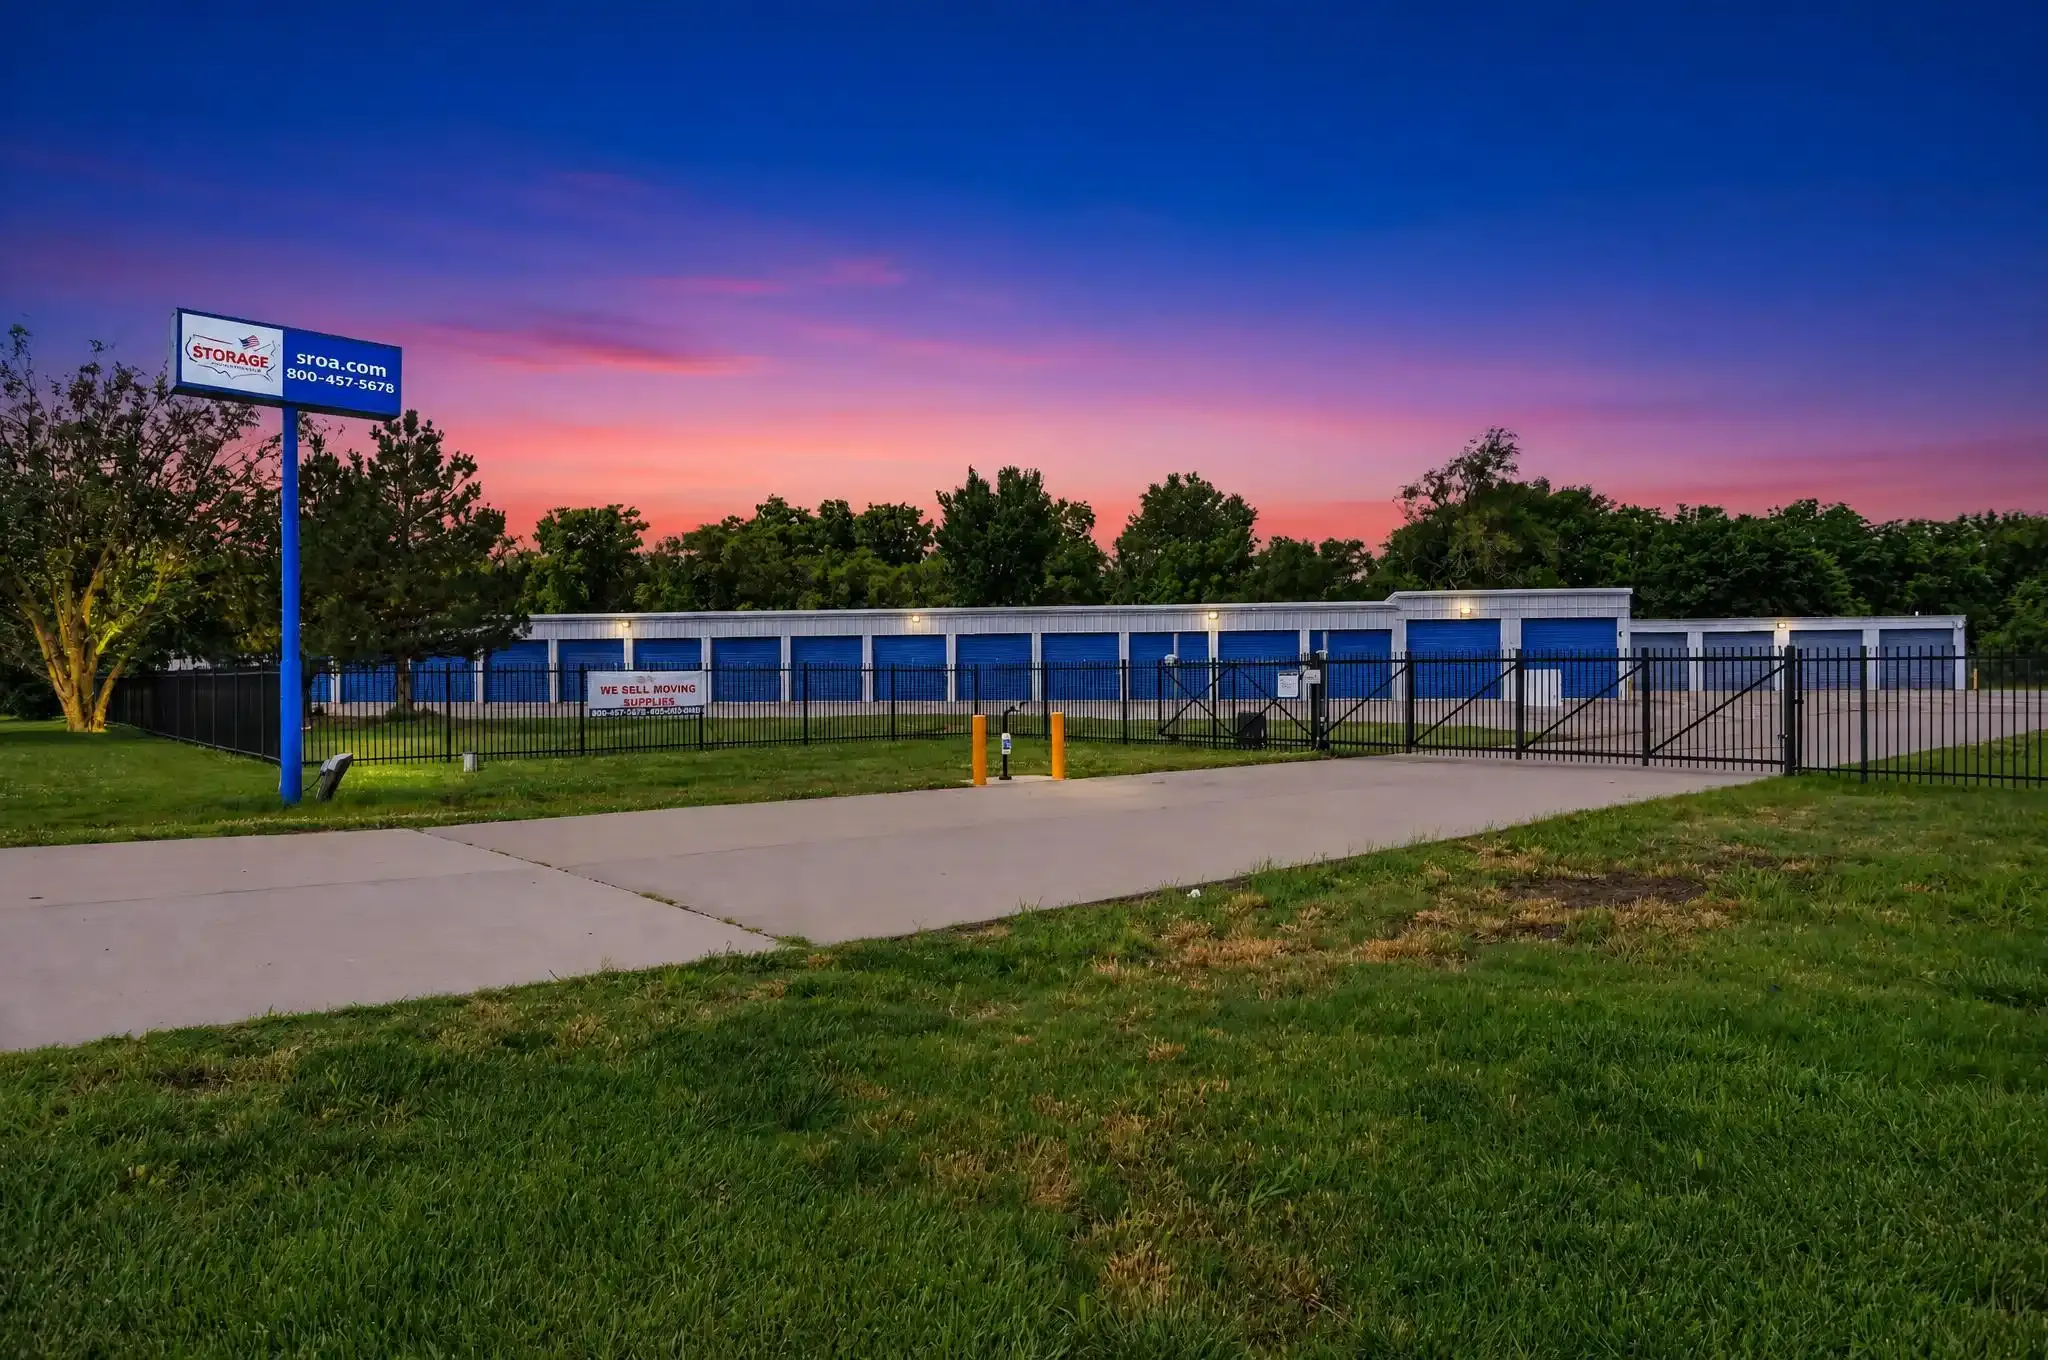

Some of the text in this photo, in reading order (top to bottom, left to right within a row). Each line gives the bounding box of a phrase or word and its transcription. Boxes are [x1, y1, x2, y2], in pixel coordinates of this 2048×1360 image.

[193, 345, 269, 369] STORAGE
[296, 352, 387, 378] sroa.com
[286, 367, 395, 394] 800-457-5678
[600, 684, 696, 695] WE SELL MOVING
[623, 697, 675, 707] SUPPLIES
